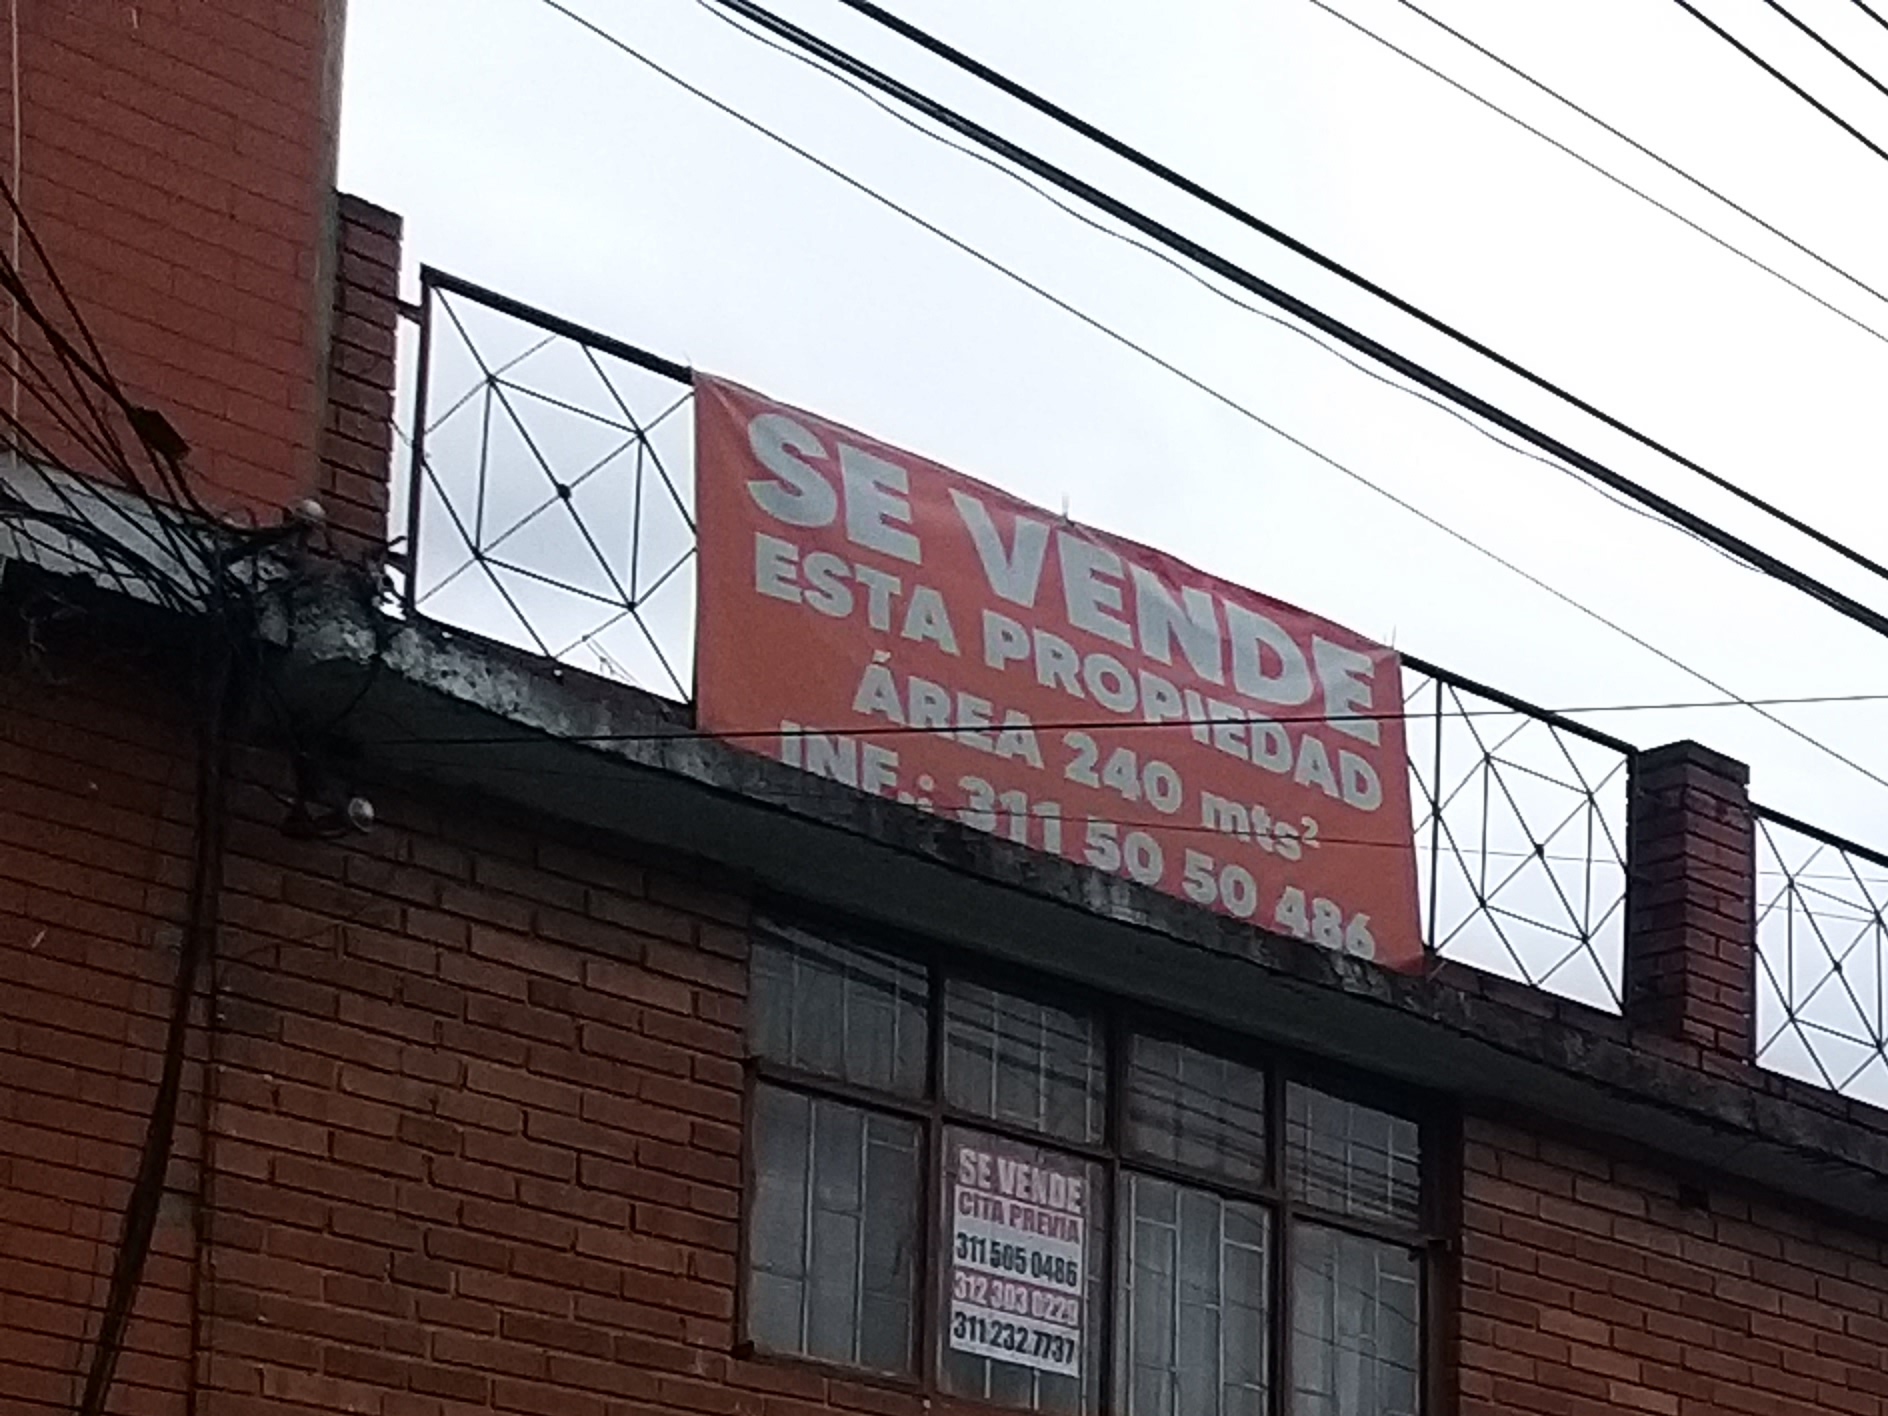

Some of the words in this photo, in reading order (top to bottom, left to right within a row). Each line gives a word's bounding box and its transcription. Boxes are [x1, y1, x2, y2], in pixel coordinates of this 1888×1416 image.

[748, 412, 921, 564] SE
[949, 488, 1381, 746] VENDE
[755, 532, 960, 656] ESTA
[982, 608, 1383, 811] PROPIEDAD
[853, 649, 1044, 769] ÁREA
[1063, 732, 1183, 814] 240
[957, 775, 1062, 856] 311
[1083, 815, 1164, 887] 50
[1182, 849, 1257, 918] 50
[1275, 885, 1376, 961] 486
[958, 1148, 991, 1187] SE
[997, 1158, 1082, 1215] VENDE
[958, 1190, 1004, 1225] CITA
[1009, 1205, 1080, 1245] PREVIA
[954, 1270, 988, 1304] 312
[957, 1232, 988, 1265] 311
[989, 1241, 1028, 1275] 505
[1031, 1251, 1078, 1288] 0486
[953, 1311, 987, 1346] 311
[990, 1320, 1029, 1352] 232
[1032, 1330, 1076, 1365] 7737
